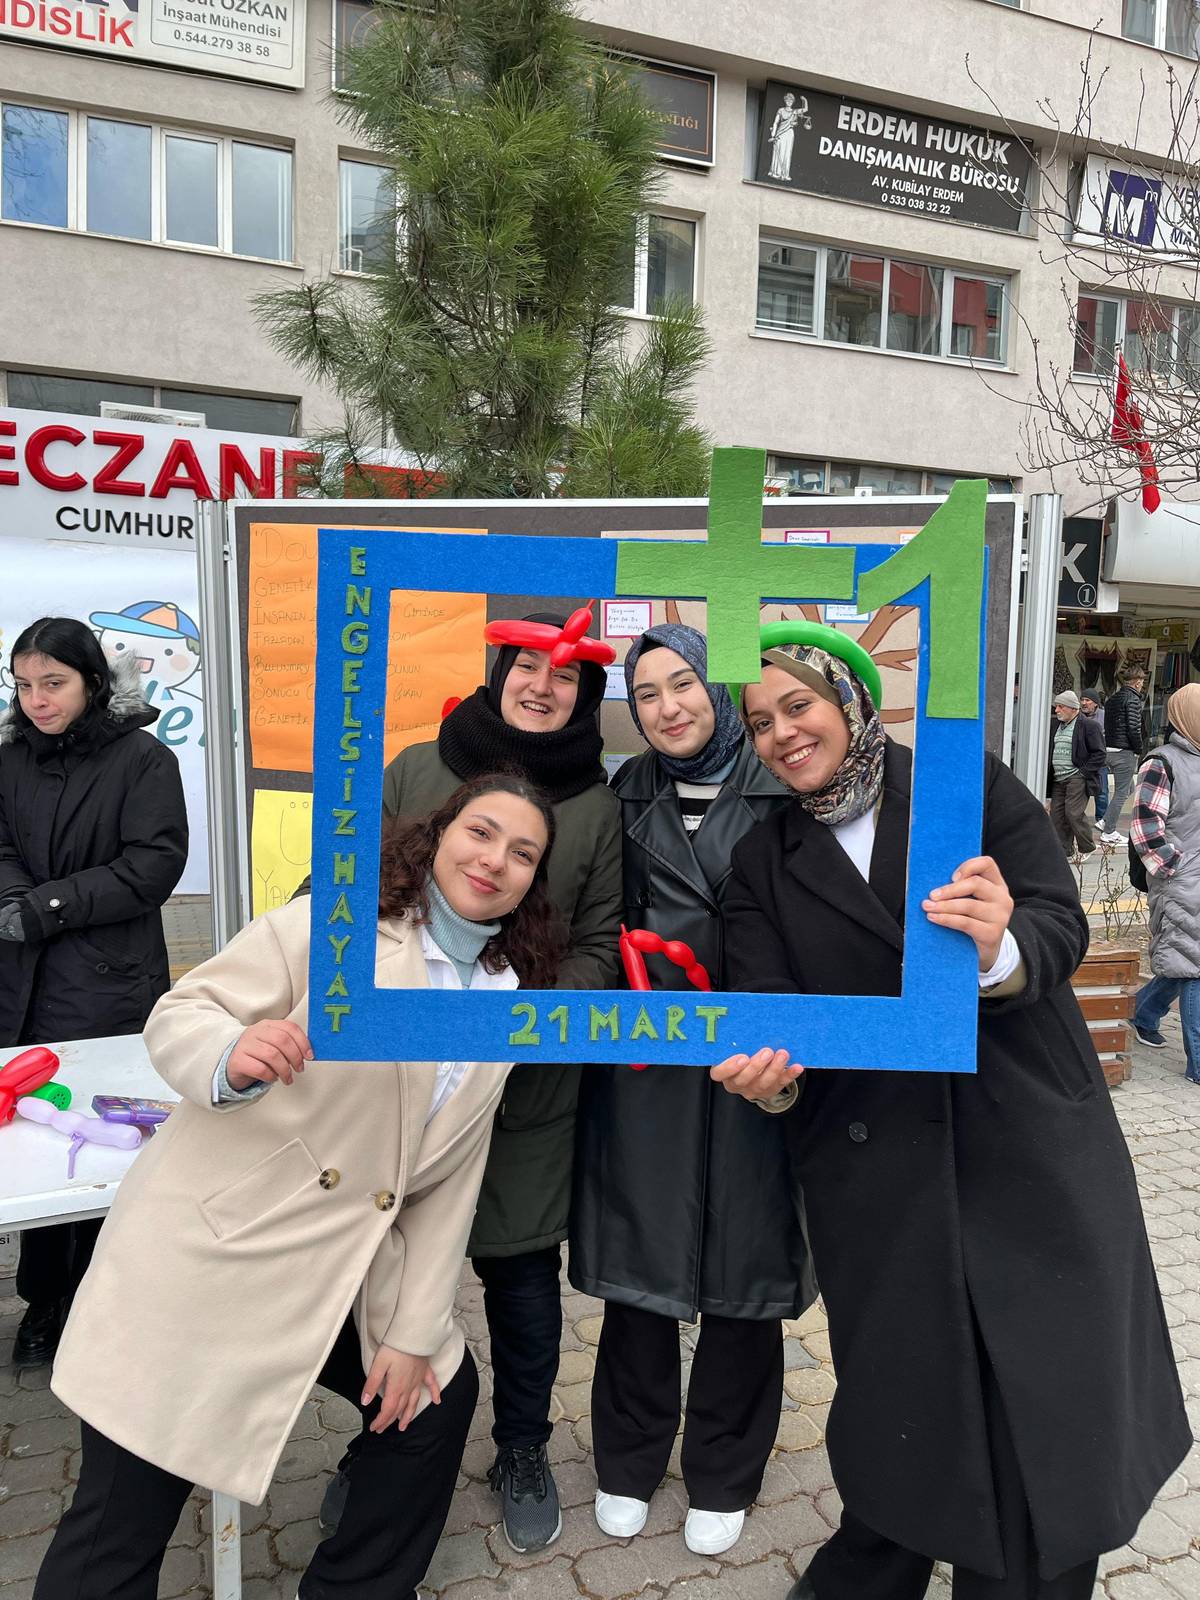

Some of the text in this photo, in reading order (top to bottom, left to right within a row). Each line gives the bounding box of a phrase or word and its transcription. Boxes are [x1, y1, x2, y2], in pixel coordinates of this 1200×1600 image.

[163, 2, 206, 22] İnşaat
[209, 13, 281, 38] Mühendisi
[174, 29, 270, 57] 0.544.279 38 58
[837, 104, 1012, 165] ERDEM HUKUK
[818, 136, 1020, 194] DANIŞMANLIK BÜROSU
[871, 175, 964, 203] AV. KUBİLAY ERDEM
[881, 192, 951, 215] 0 533 038 32 22
[56, 506, 194, 540] CUMHUR
[323, 546, 371, 1034] ENGELSİZ HAYAT
[508, 1002, 729, 1045] 21 MART
